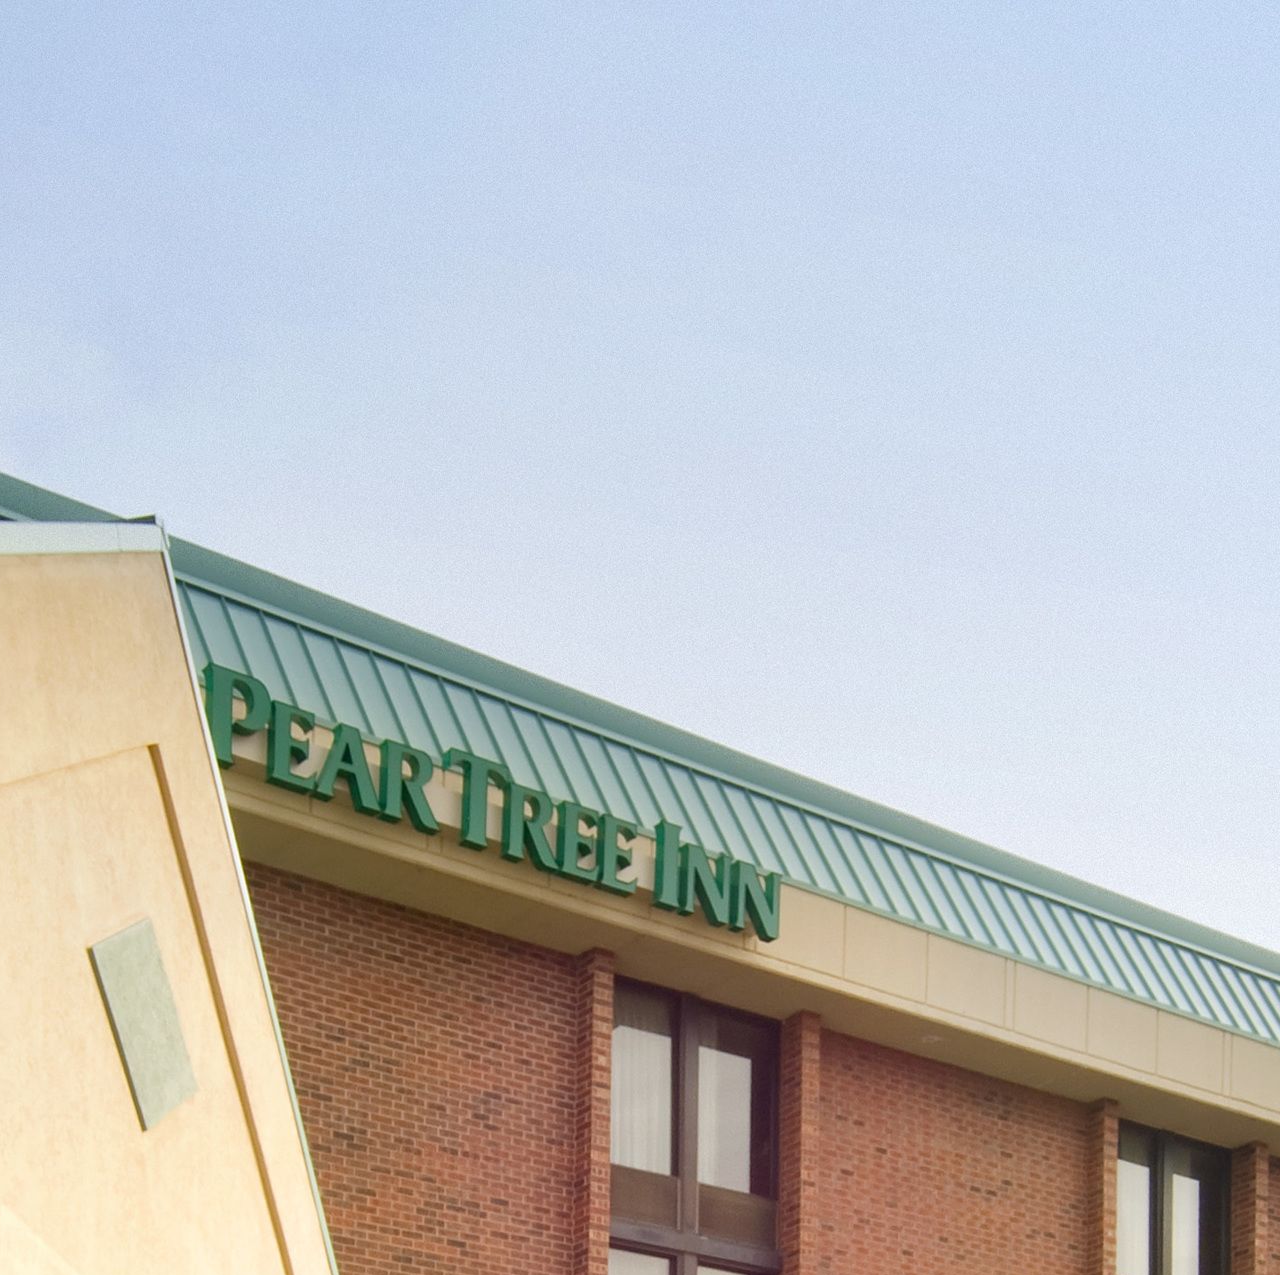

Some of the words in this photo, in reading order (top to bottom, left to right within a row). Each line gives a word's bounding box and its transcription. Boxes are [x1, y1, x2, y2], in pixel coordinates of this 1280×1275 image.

[203, 663, 439, 834] PEAR
[443, 748, 638, 896] TREE
[652, 819, 782, 942] INN
